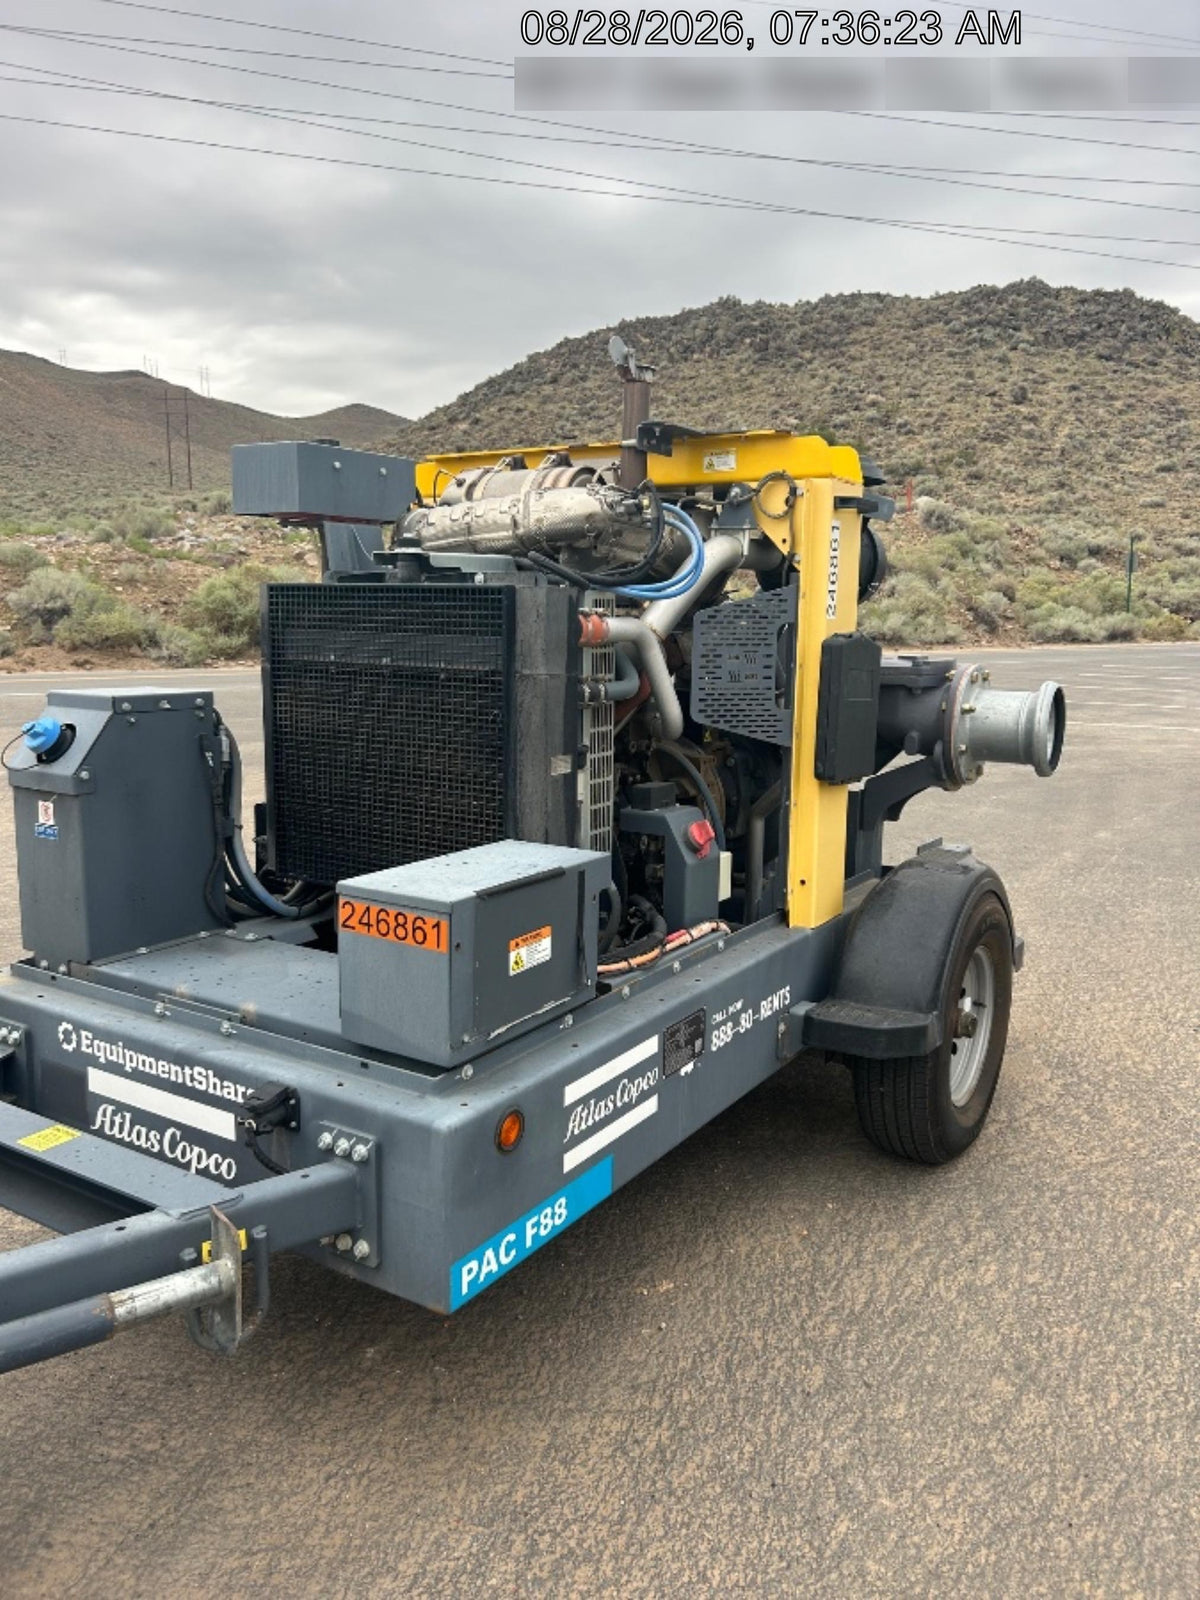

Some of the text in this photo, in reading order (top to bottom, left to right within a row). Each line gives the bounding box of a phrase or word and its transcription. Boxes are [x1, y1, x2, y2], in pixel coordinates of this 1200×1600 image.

[341, 901, 442, 949] 246861
[711, 985, 791, 1052] 888-80-RENTS
[91, 1104, 160, 1152] Atlas
[163, 1127, 236, 1179] Copco
[563, 1066, 659, 1143] Atlas Copco
[462, 1197, 567, 1296] PAC F88
